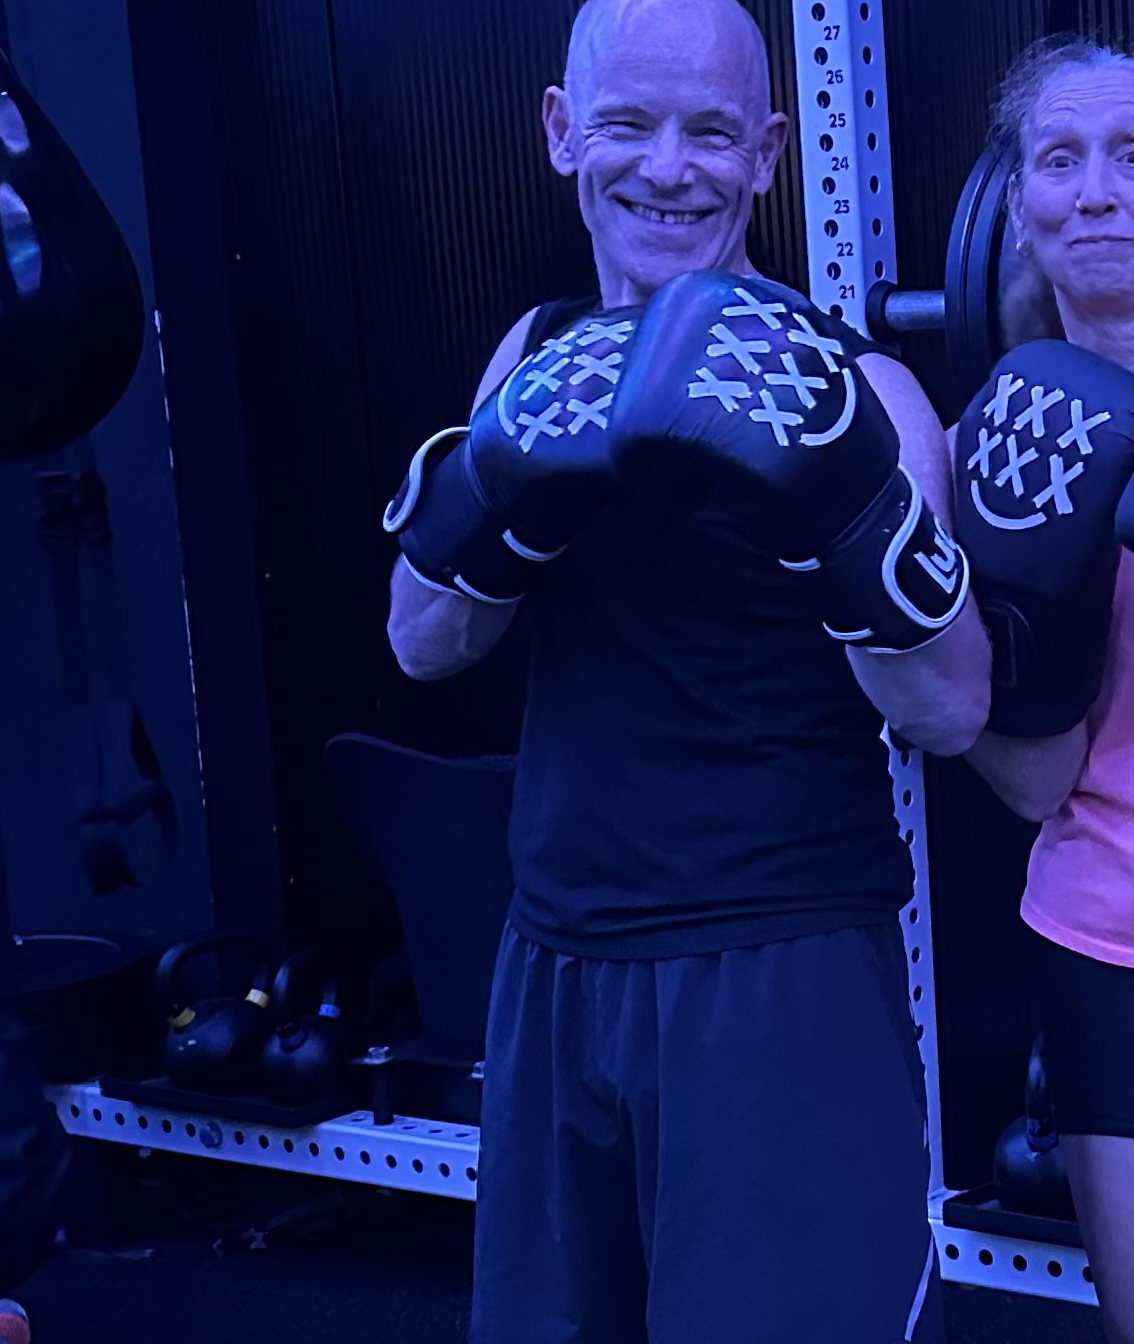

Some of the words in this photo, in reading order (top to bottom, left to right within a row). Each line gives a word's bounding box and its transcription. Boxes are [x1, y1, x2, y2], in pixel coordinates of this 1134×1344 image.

[823, 25, 841, 41] 27
[826, 69, 844, 86] 26
[828, 112, 846, 129] 25
[831, 156, 850, 172] 24
[834, 199, 851, 215] 23
[836, 242, 854, 258] 22
[839, 285, 856, 300] 21
